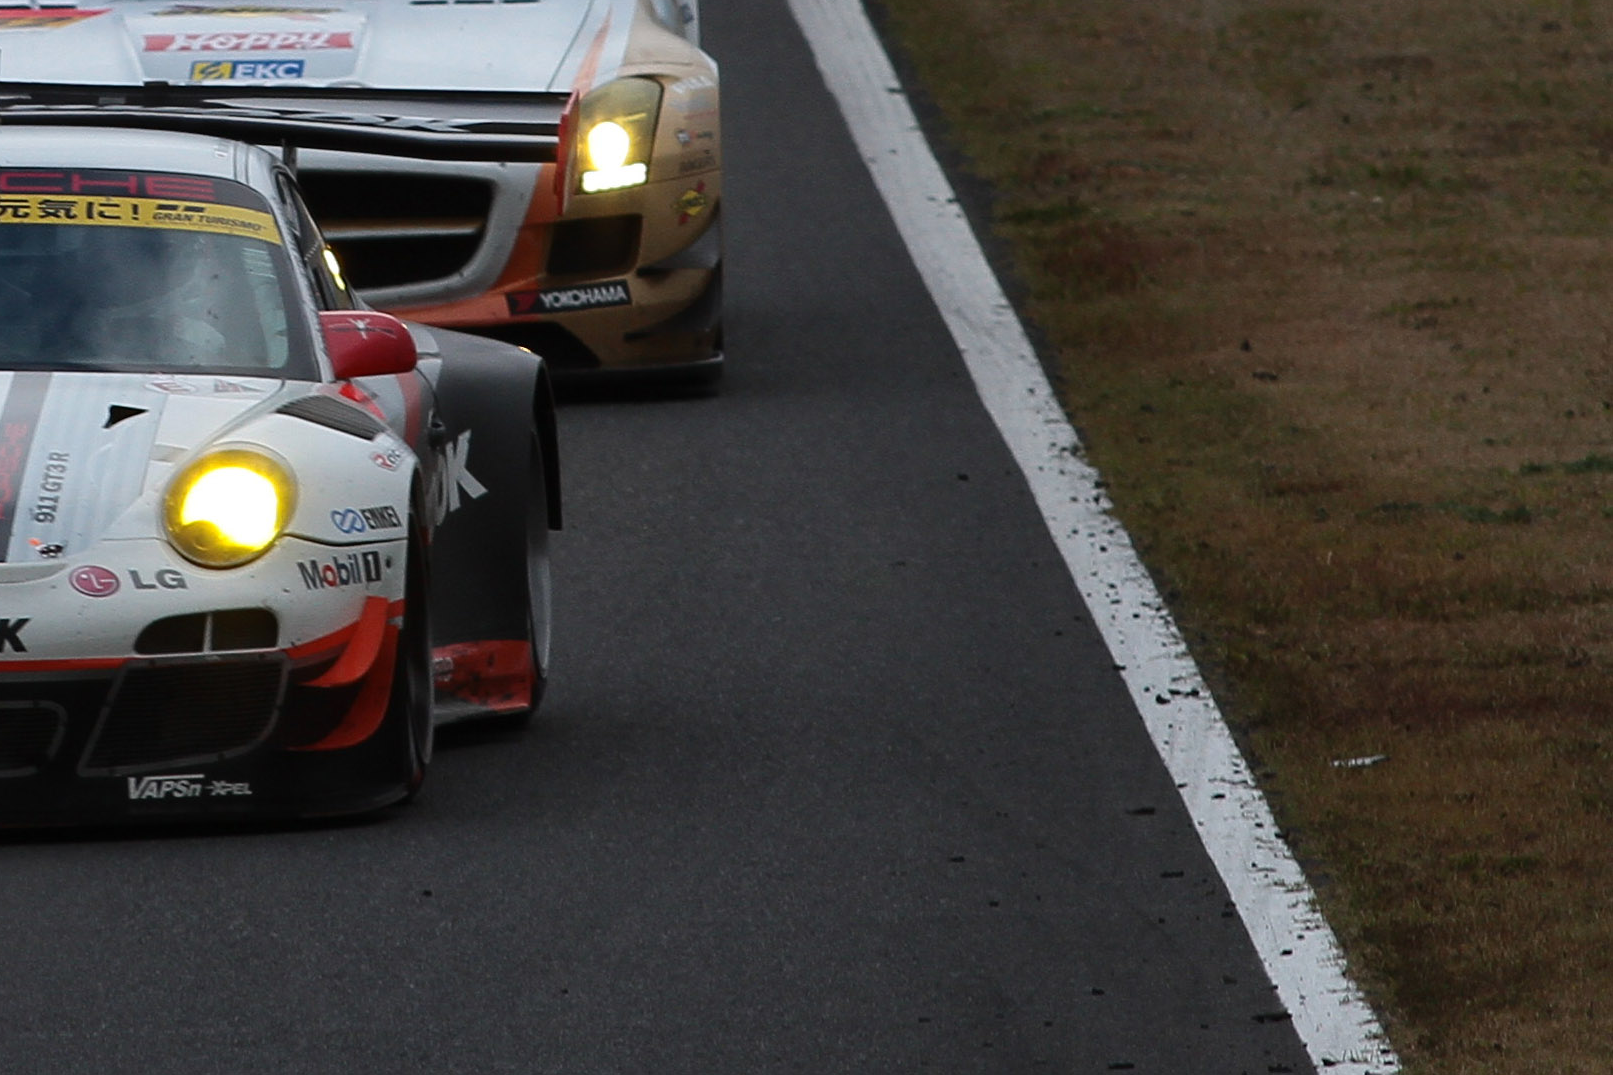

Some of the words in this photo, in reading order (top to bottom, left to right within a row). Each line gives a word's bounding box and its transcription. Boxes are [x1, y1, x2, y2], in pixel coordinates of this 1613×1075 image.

[234, 63, 303, 79] EKC
[152, 211, 194, 223] GRAN
[197, 214, 262, 232] TURISMO
[539, 284, 628, 309] YOKOHAMA
[34, 495, 61, 524] 911
[360, 505, 402, 530] ENKEI
[128, 569, 189, 591] LG
[297, 552, 363, 590] Mobil
[363, 551, 381, 582] 1
